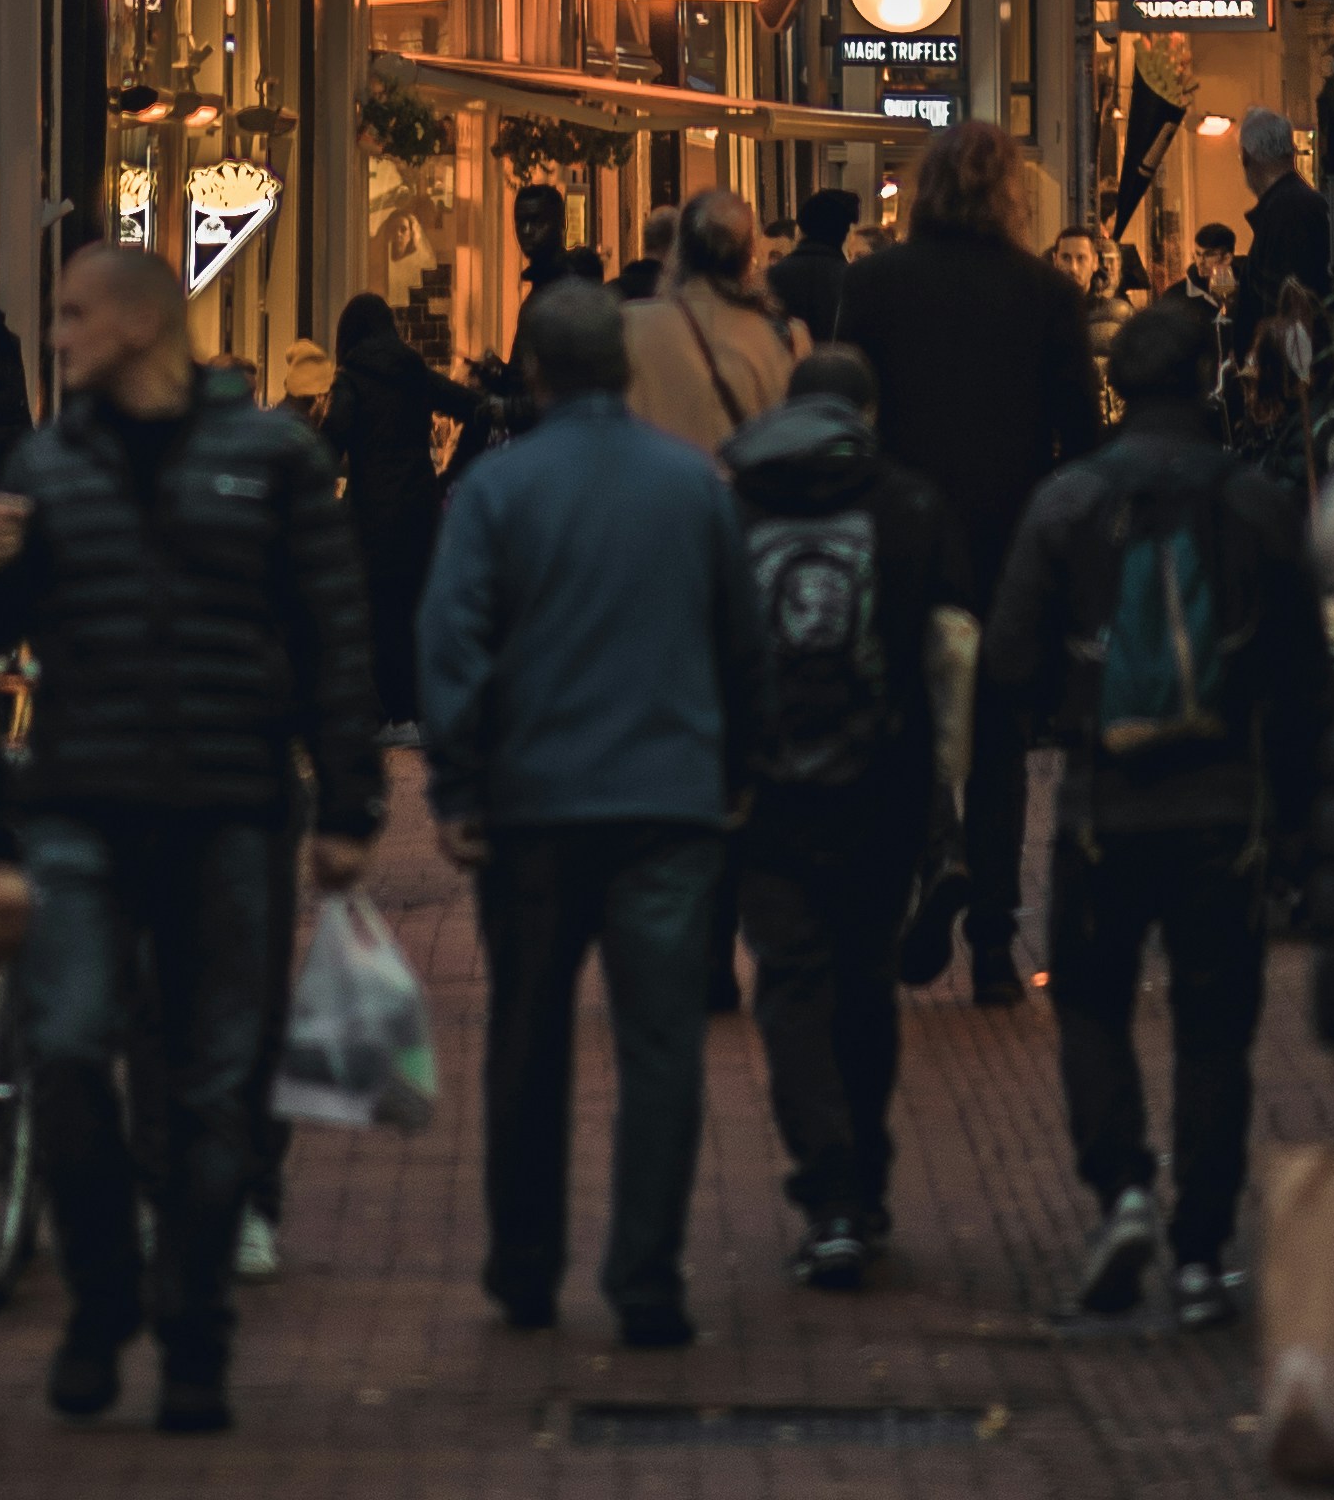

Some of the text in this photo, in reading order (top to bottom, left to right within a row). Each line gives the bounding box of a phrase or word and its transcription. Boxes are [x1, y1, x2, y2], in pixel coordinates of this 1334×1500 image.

[1134, 0, 1255, 18] BURGERBAR
[844, 41, 957, 61] MAGIC TRUFFLES
